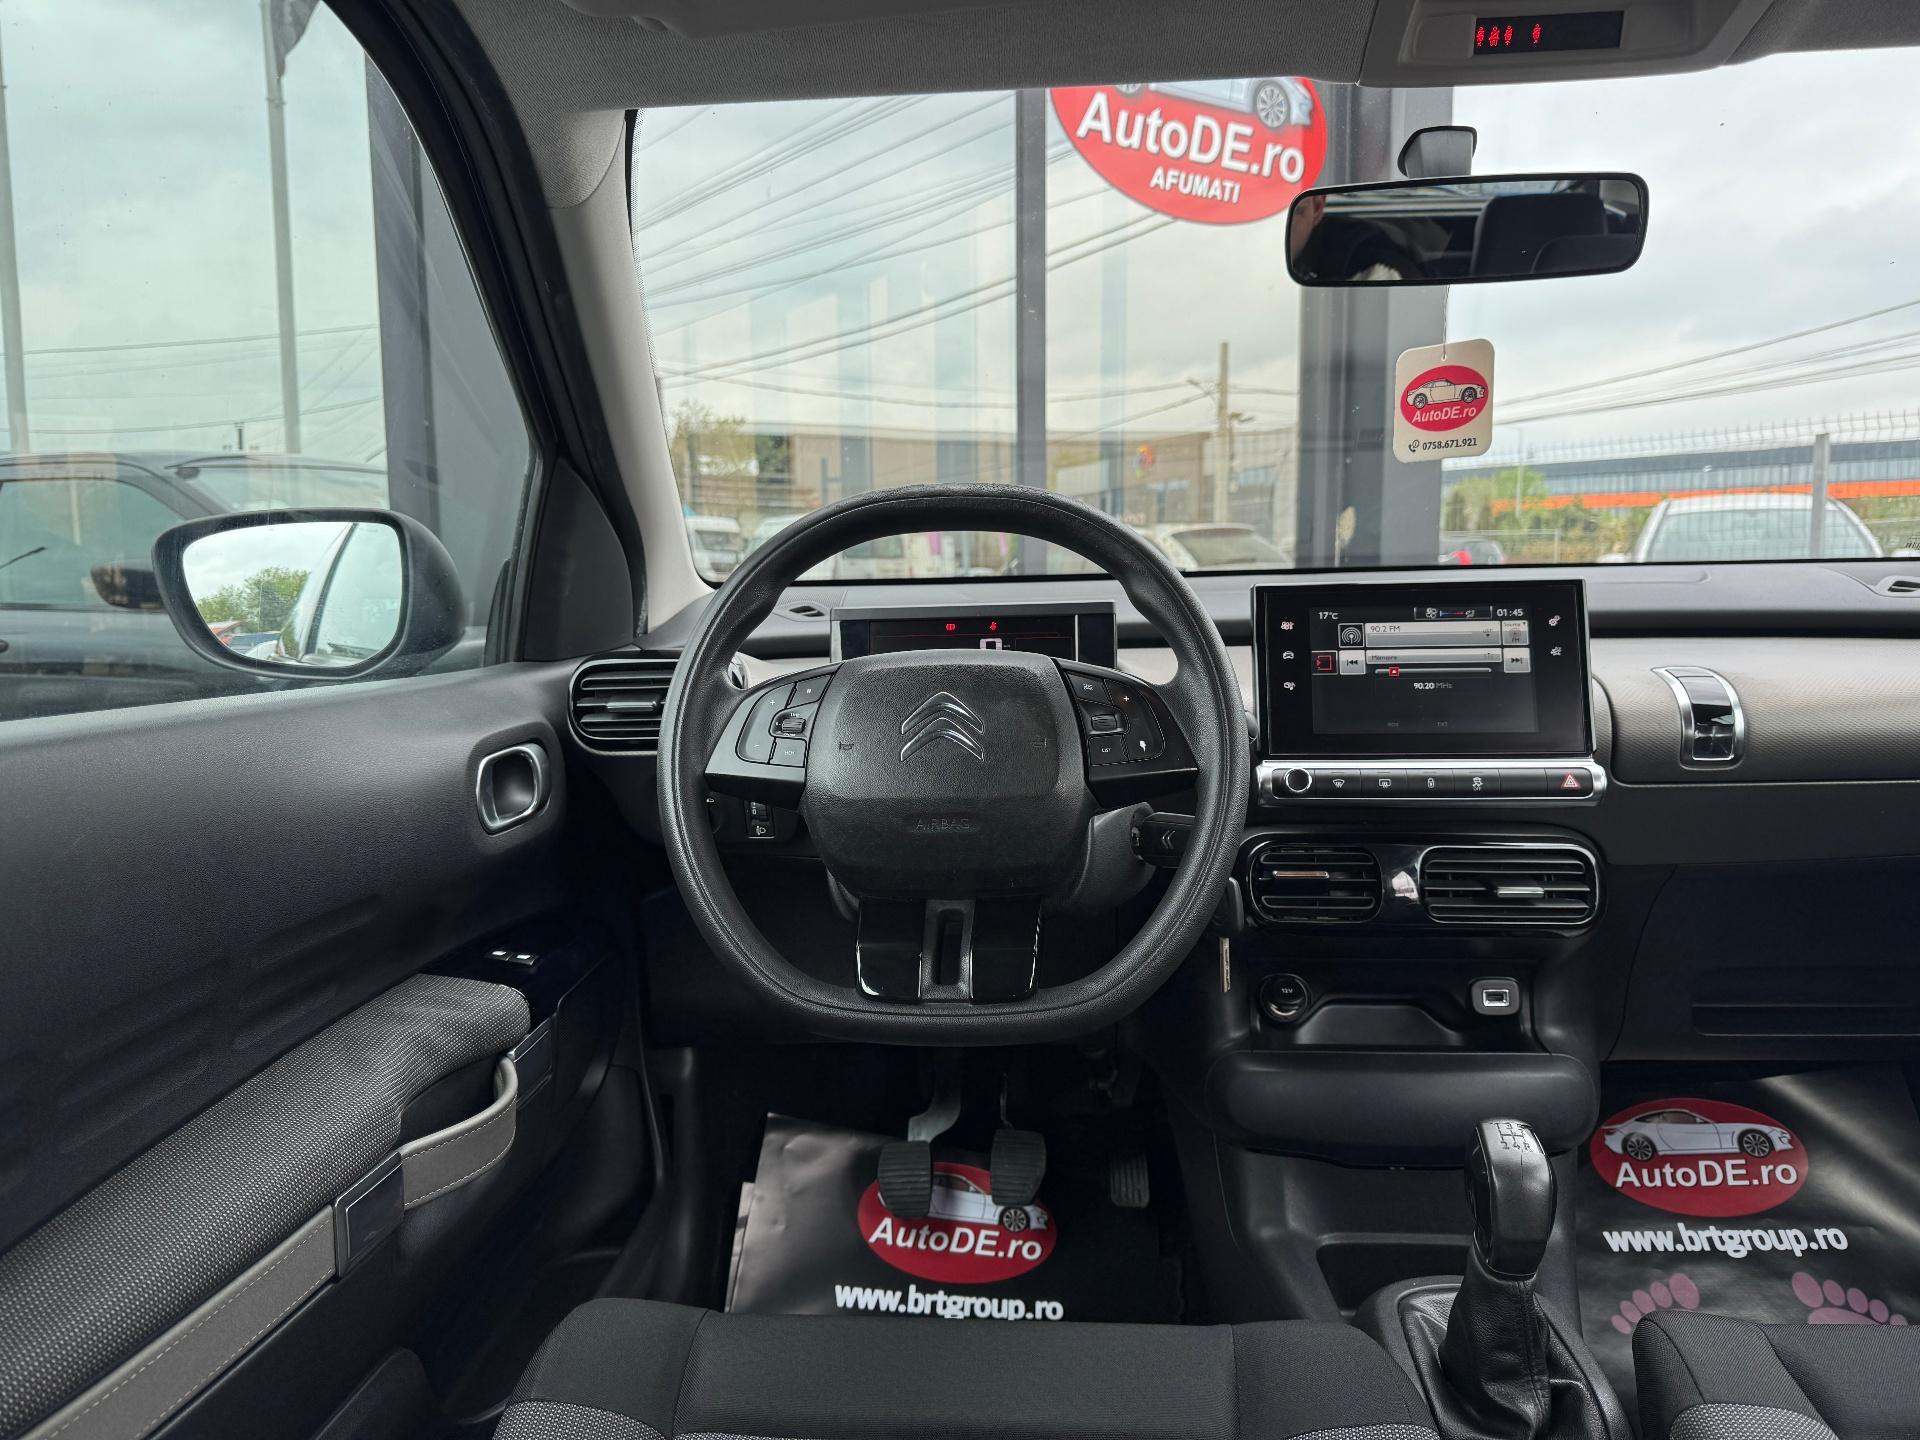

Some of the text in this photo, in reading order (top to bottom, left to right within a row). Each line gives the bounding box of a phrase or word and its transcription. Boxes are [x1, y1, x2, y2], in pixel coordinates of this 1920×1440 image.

[1076, 91, 1305, 184] AutoDE.ro
[1150, 166, 1241, 204] AFUMATI
[1411, 406, 1477, 423] AutoDE.ro
[1422, 438, 1477, 451] 0758.671.921
[1370, 625, 1401, 633] 90.2 FM
[1413, 682, 1435, 690] 90.20
[1615, 1159, 1798, 1188] AutoDE.ro
[868, 1217, 1043, 1260] AutoDE.ro
[1602, 1222, 1849, 1258] www.brtgroup.ro
[834, 1284, 1064, 1321] www.brtgroup.ro
